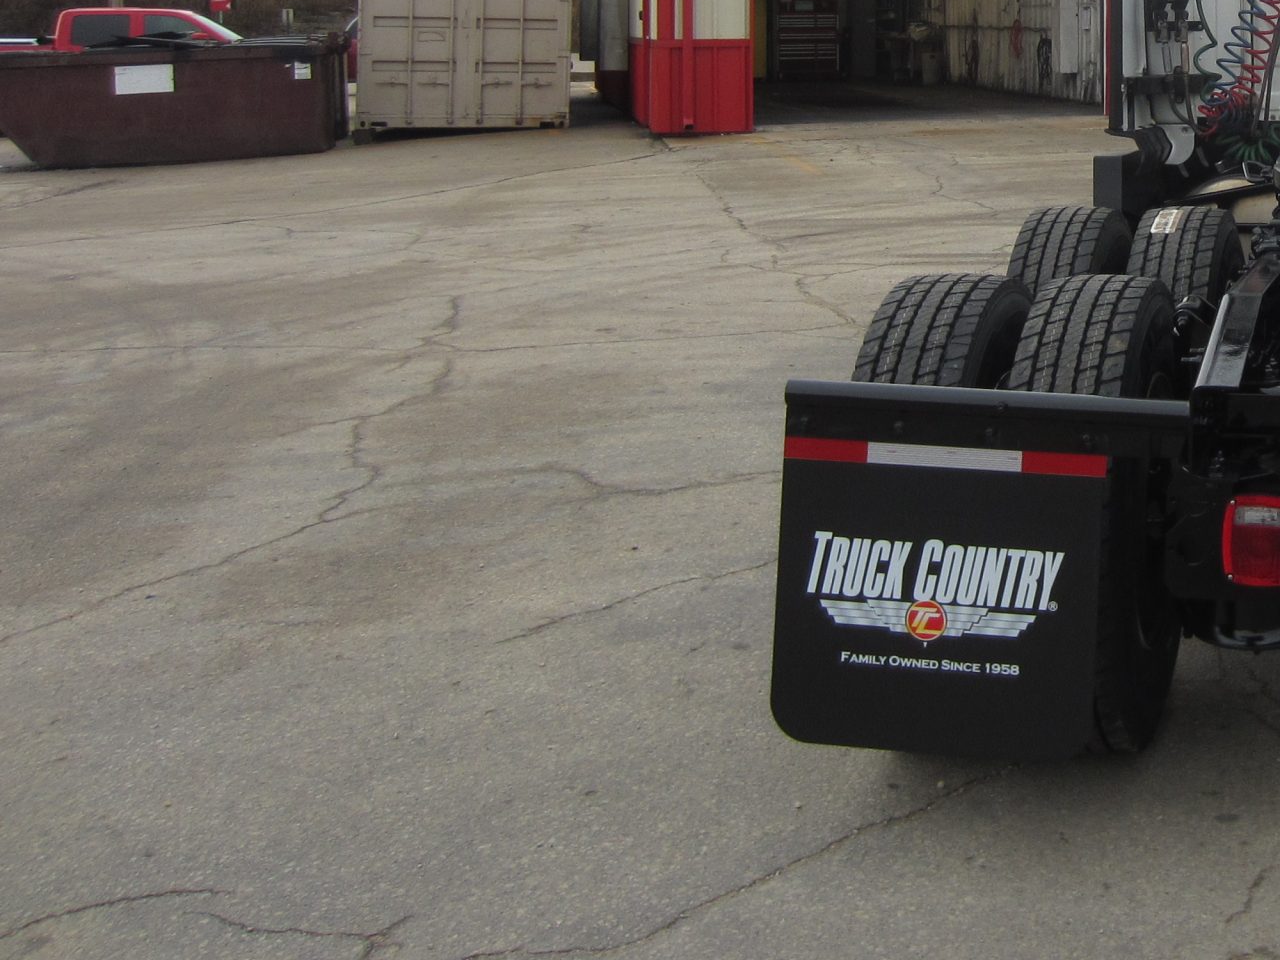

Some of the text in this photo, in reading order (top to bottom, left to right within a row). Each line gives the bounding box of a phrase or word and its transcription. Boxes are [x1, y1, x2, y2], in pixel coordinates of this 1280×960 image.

[807, 530, 1065, 610] TRUCK COUNTRY
[841, 651, 1020, 676] FAMILY OWNED SINCE 1958
